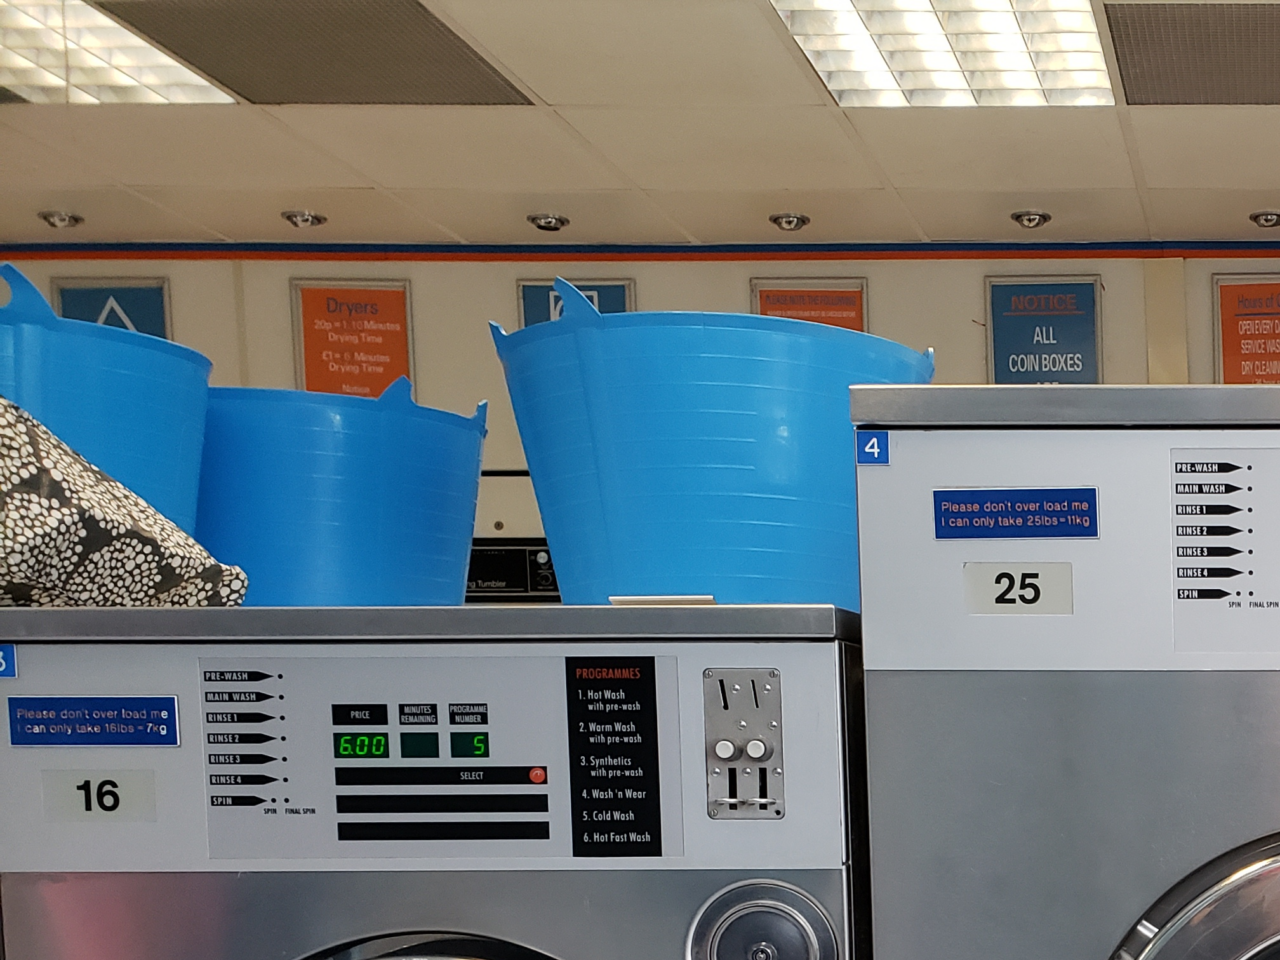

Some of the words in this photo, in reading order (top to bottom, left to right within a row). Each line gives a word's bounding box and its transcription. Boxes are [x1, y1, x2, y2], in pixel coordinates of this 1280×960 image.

[326, 297, 379, 317] Dryers
[1011, 294, 1077, 310] NOTICE
[1238, 294, 1263, 309] Hours
[1265, 294, 1275, 308] of
[1238, 320, 1255, 335] OPEN
[1255, 320, 1274, 334] EVERY
[328, 332, 358, 344] Drying
[360, 333, 383, 343] Time
[1033, 326, 1057, 344] ALL
[1241, 339, 1265, 354] SERVICE
[329, 362, 360, 373] Drying
[361, 363, 384, 373] Time
[1009, 354, 1039, 372] COIN
[1042, 354, 1083, 372] BOXES
[1241, 361, 1254, 375] DRY
[864, 437, 880, 458] 4
[1176, 463, 1219, 472] PRE-WASH
[1177, 484, 1199, 493] MAIN
[1202, 484, 1226, 493] WASH
[941, 501, 980, 513] Please
[984, 501, 1012, 512] don't
[1016, 503, 1040, 512] over
[1043, 500, 1068, 511] load
[1072, 502, 1089, 511] me
[1177, 505, 1201, 514] RINSE
[949, 518, 970, 527] can
[972, 516, 995, 529] only
[998, 516, 1023, 526] take
[1178, 526, 1202, 535] RINSE
[1178, 547, 1202, 556] RINSE
[1178, 568, 1202, 577] RINSE
[477, 580, 506, 588] Tumbler
[994, 571, 1041, 604] 25
[1179, 589, 1198, 598] SPIN
[1249, 601, 1265, 609] FINAL
[16, 708, 56, 720] Please
[60, 708, 89, 719] don't
[93, 710, 118, 719] over
[121, 708, 147, 719] load
[150, 710, 169, 719] me
[350, 711, 370, 719] PRICE
[404, 705, 432, 714] MINUTES
[450, 705, 487, 713] PROGRAMME
[401, 714, 436, 723] REMAINING
[455, 714, 482, 723] NUMBER
[25, 725, 46, 734] can
[49, 723, 73, 735] only
[76, 723, 101, 734] take
[339, 736, 385, 755] 6.00
[473, 736, 485, 754] 5
[460, 771, 484, 780] SELECT
[76, 779, 121, 812] 16
